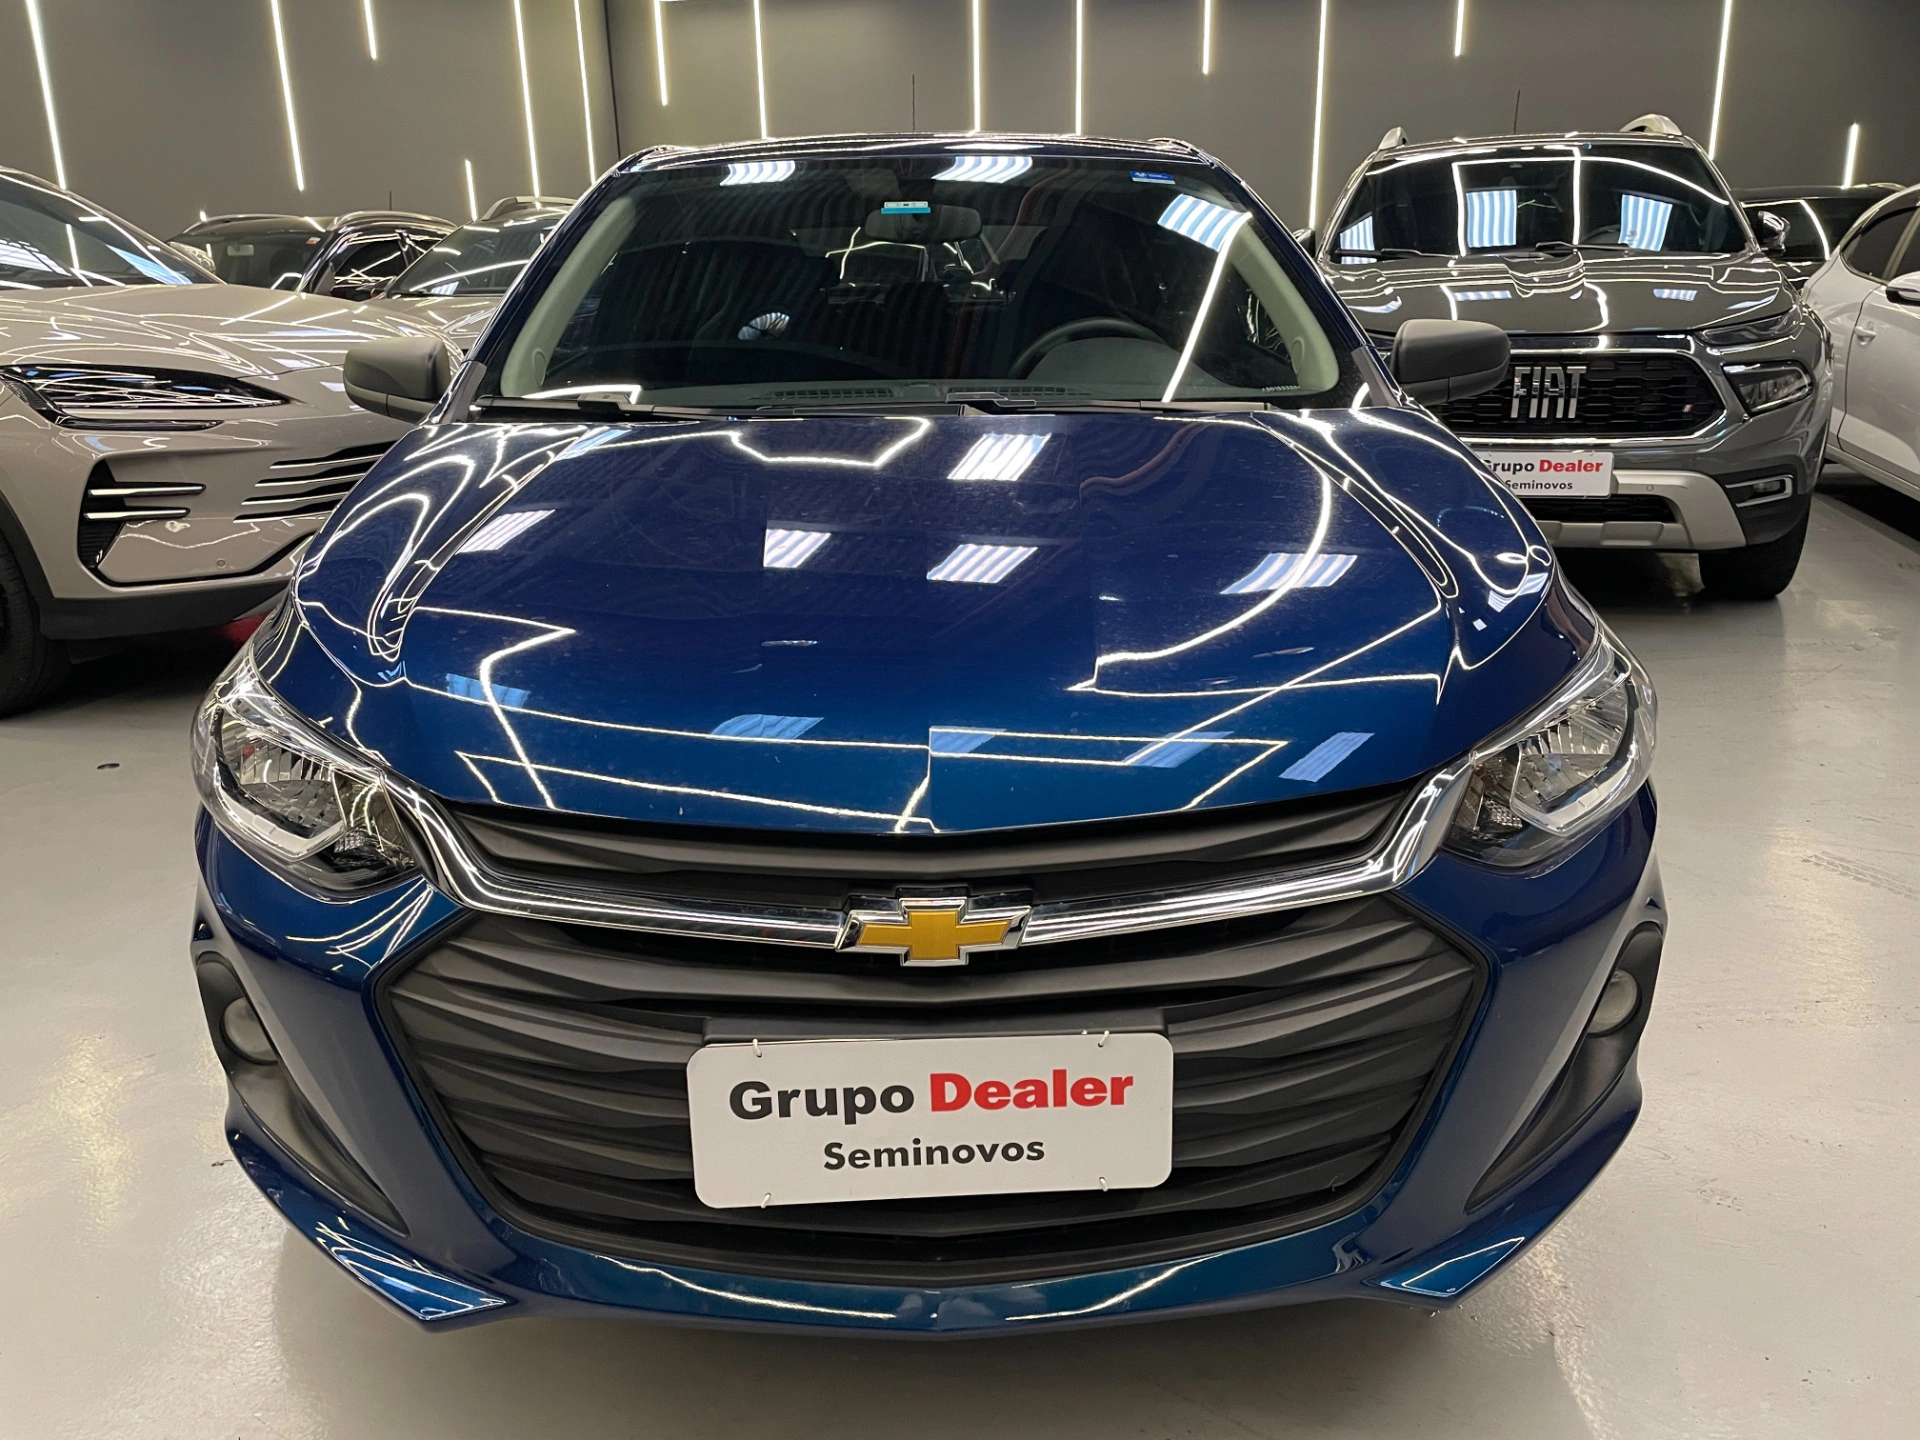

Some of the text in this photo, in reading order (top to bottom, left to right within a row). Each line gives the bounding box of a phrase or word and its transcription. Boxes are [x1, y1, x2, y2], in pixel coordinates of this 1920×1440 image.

[1510, 366, 1587, 419] FIAT
[1539, 459, 1602, 473] Dealer
[1505, 480, 1573, 491] Seminovos
[729, 1069, 1135, 1126] Grupo Dealer
[823, 1137, 1046, 1171] Seminovos
